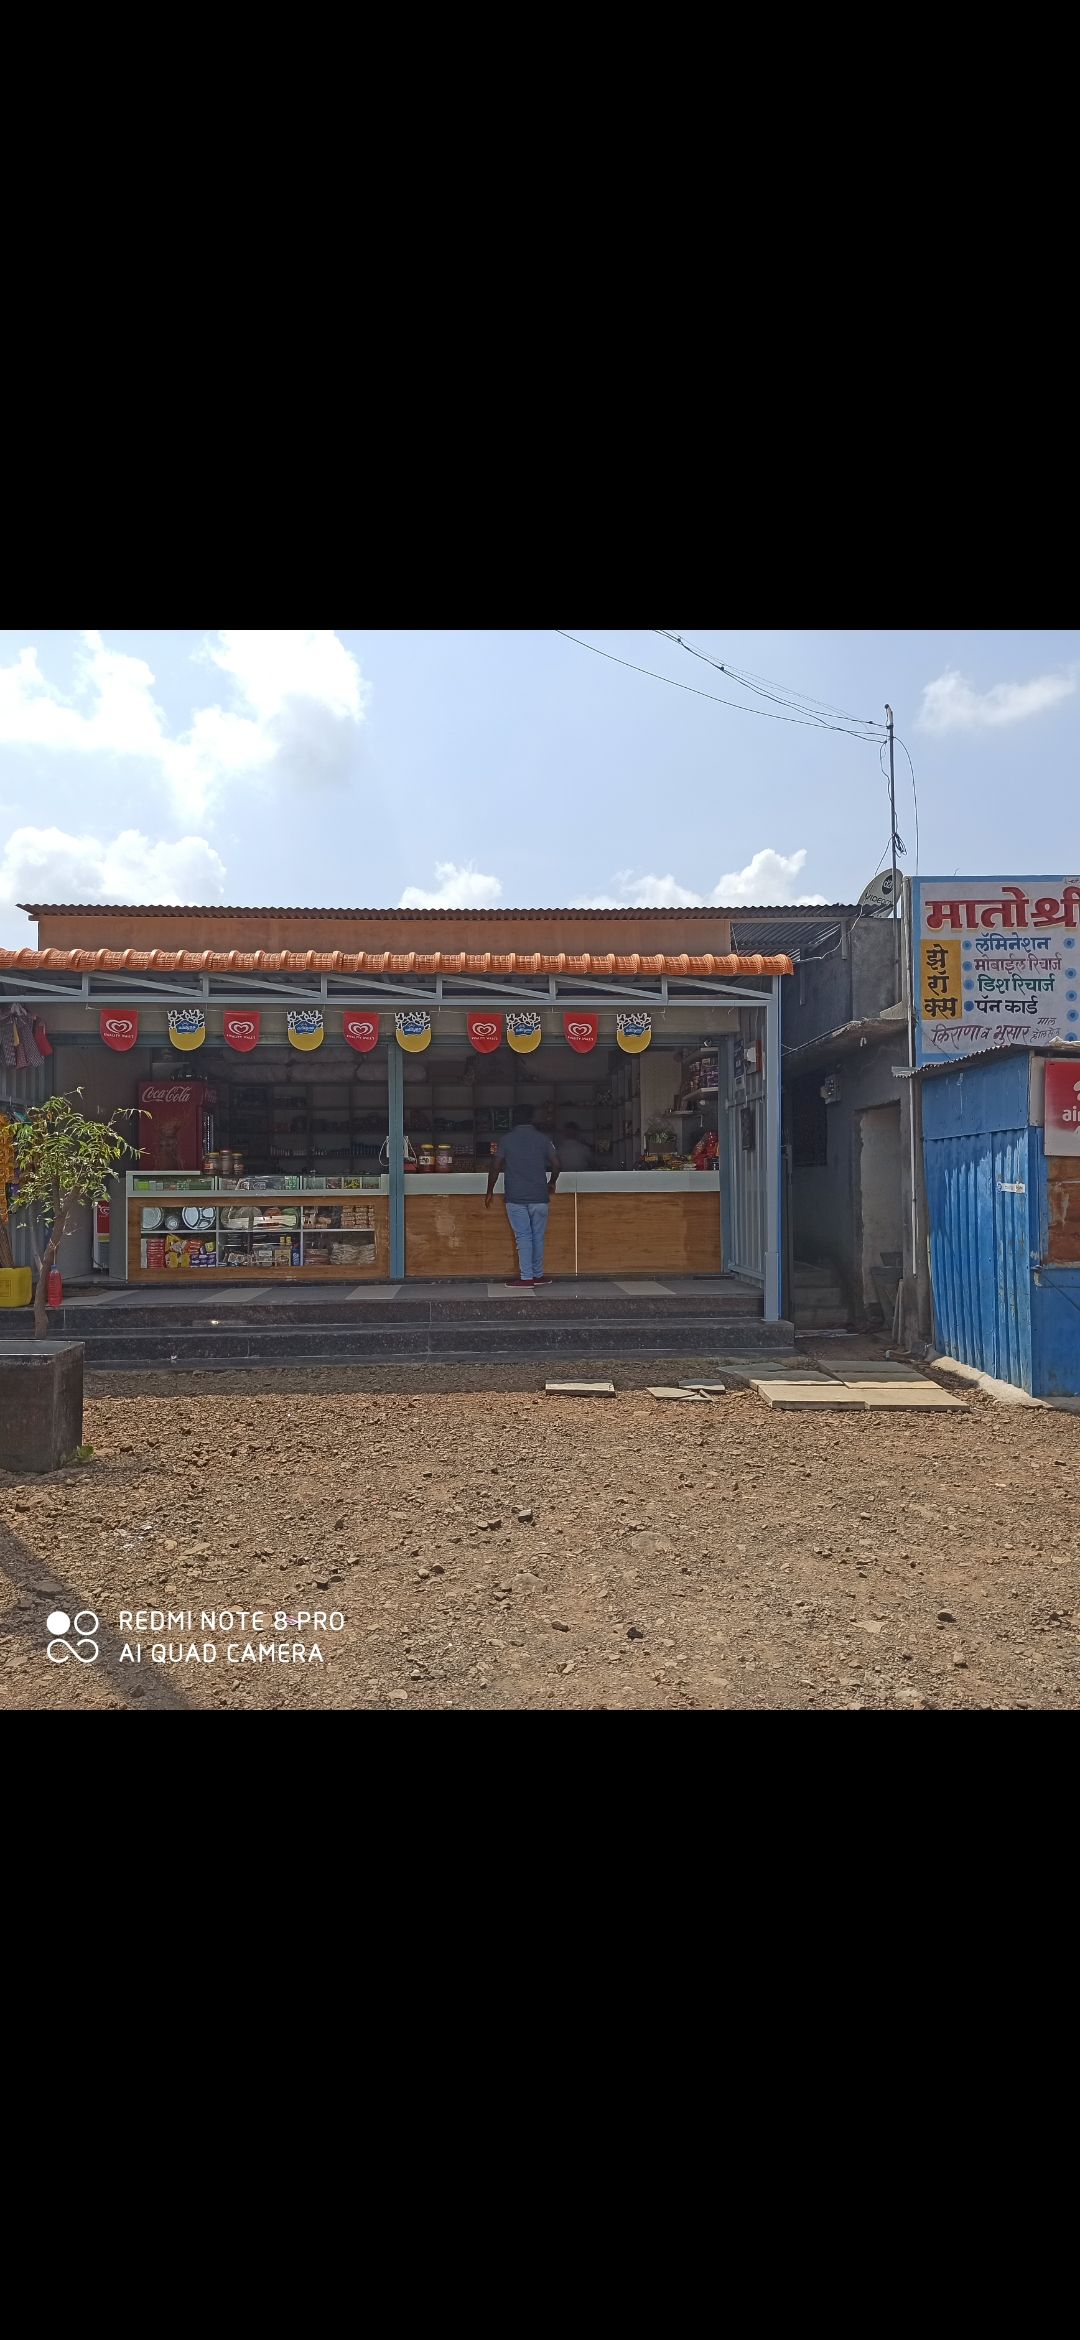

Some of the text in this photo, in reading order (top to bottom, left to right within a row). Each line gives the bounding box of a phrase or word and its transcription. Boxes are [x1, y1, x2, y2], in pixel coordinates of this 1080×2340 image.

[975, 932, 1051, 954] लॅमिनेशन
[974, 952, 1063, 974] मोबाईल रिचार्ज
[977, 973, 1055, 995] डिश रिचार्ज
[975, 995, 1039, 1015] पॅन कार्ड
[141, 1086, 193, 1103] Coca-Cola
